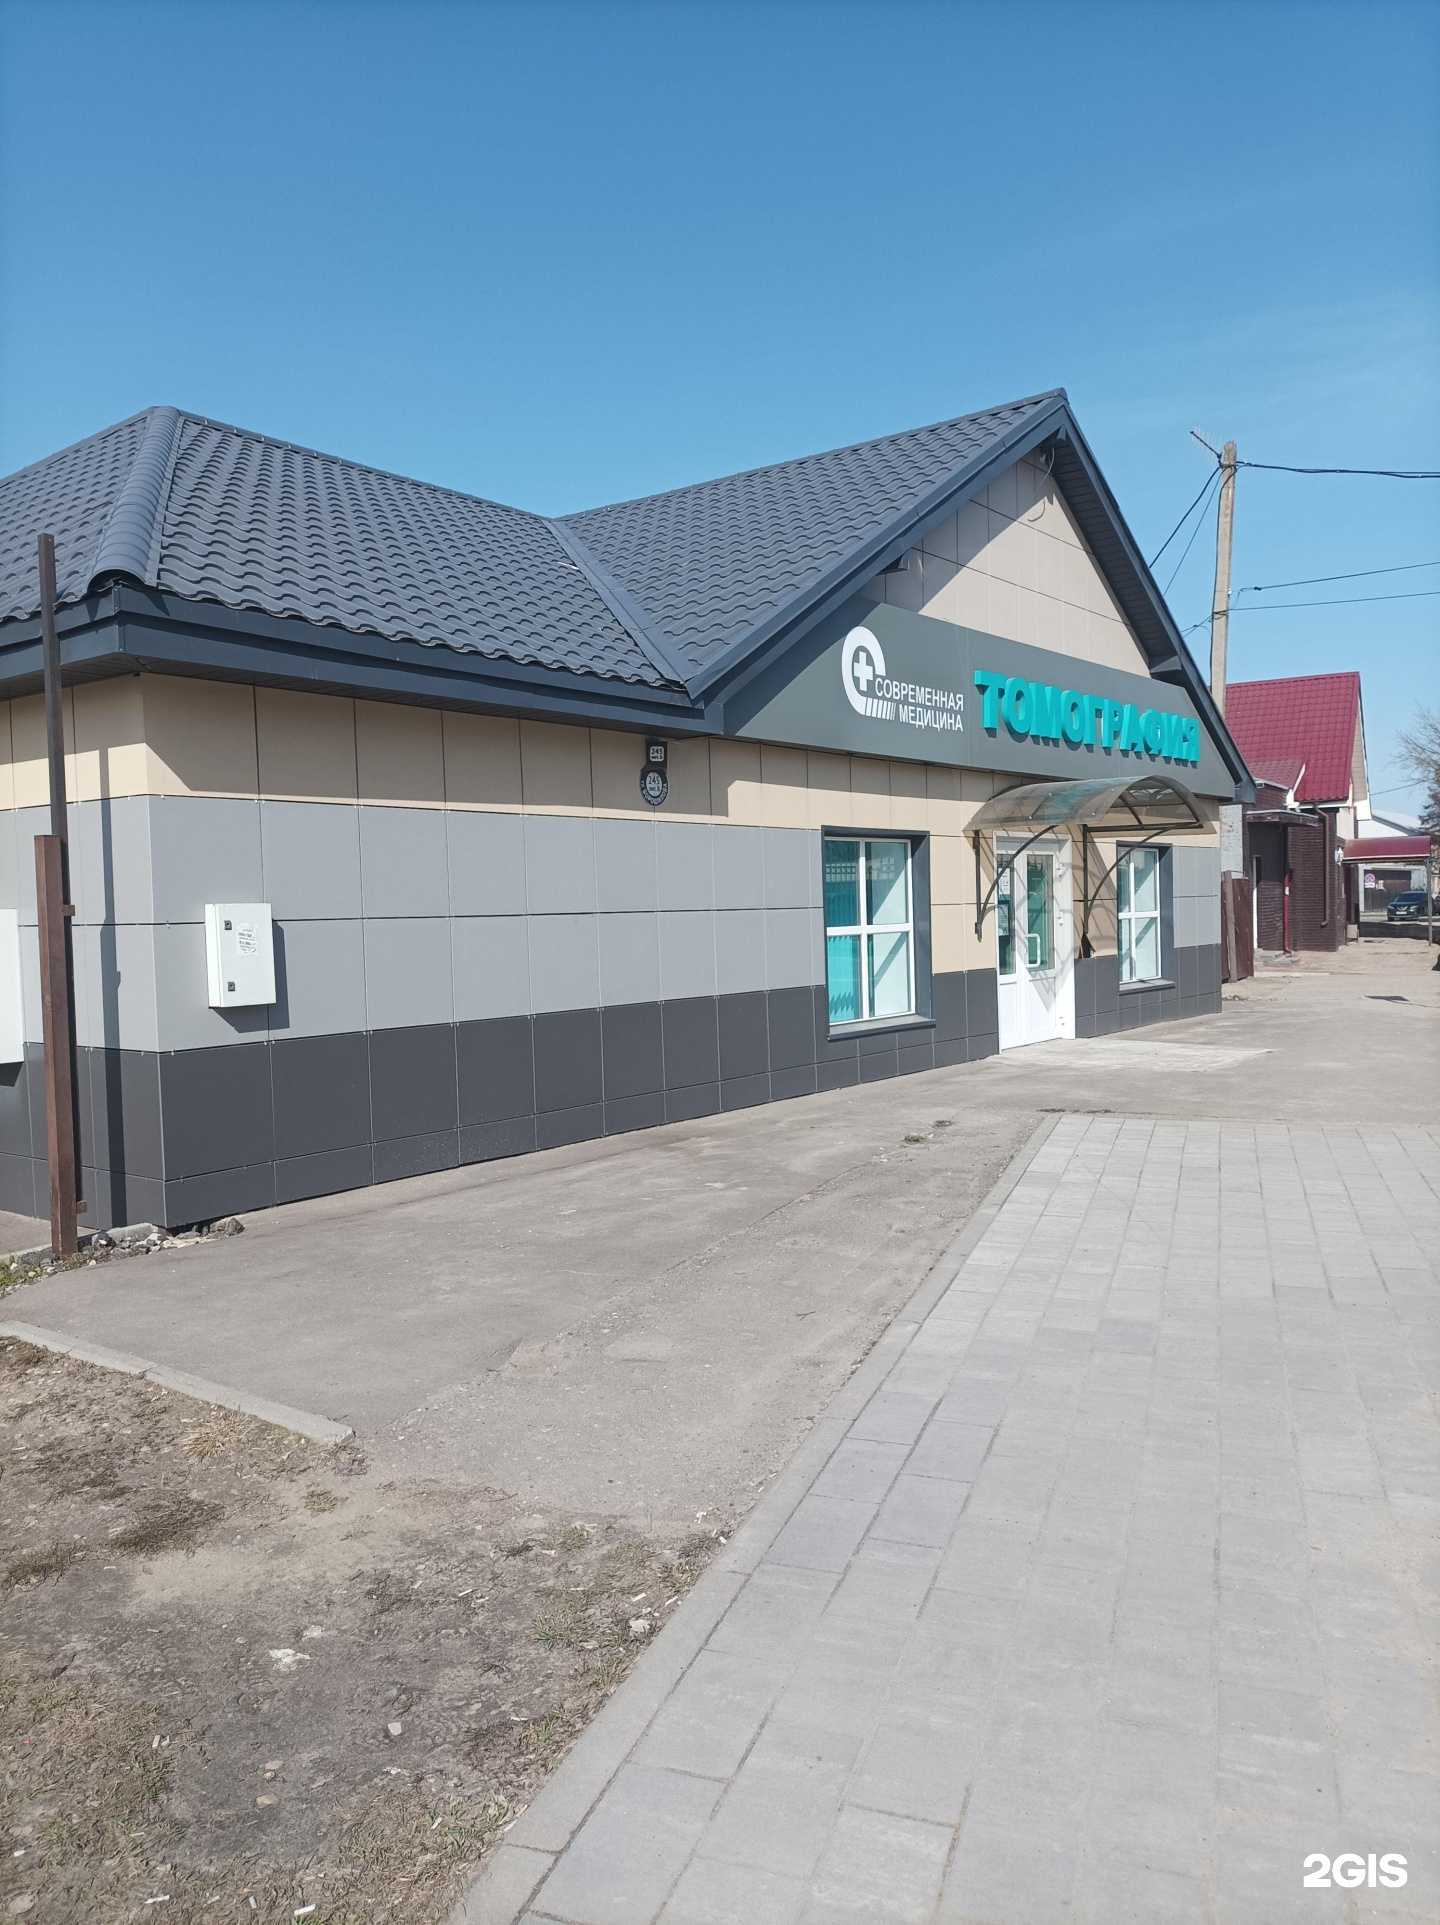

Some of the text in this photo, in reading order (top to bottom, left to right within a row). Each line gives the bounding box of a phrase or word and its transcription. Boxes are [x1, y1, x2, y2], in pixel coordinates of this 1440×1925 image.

[875, 677, 964, 712] СОВРЕМЕННАЯ
[899, 703, 964, 733] МЕДИЦИНА
[974, 670, 1199, 762] ТОМОГРАФИЯ
